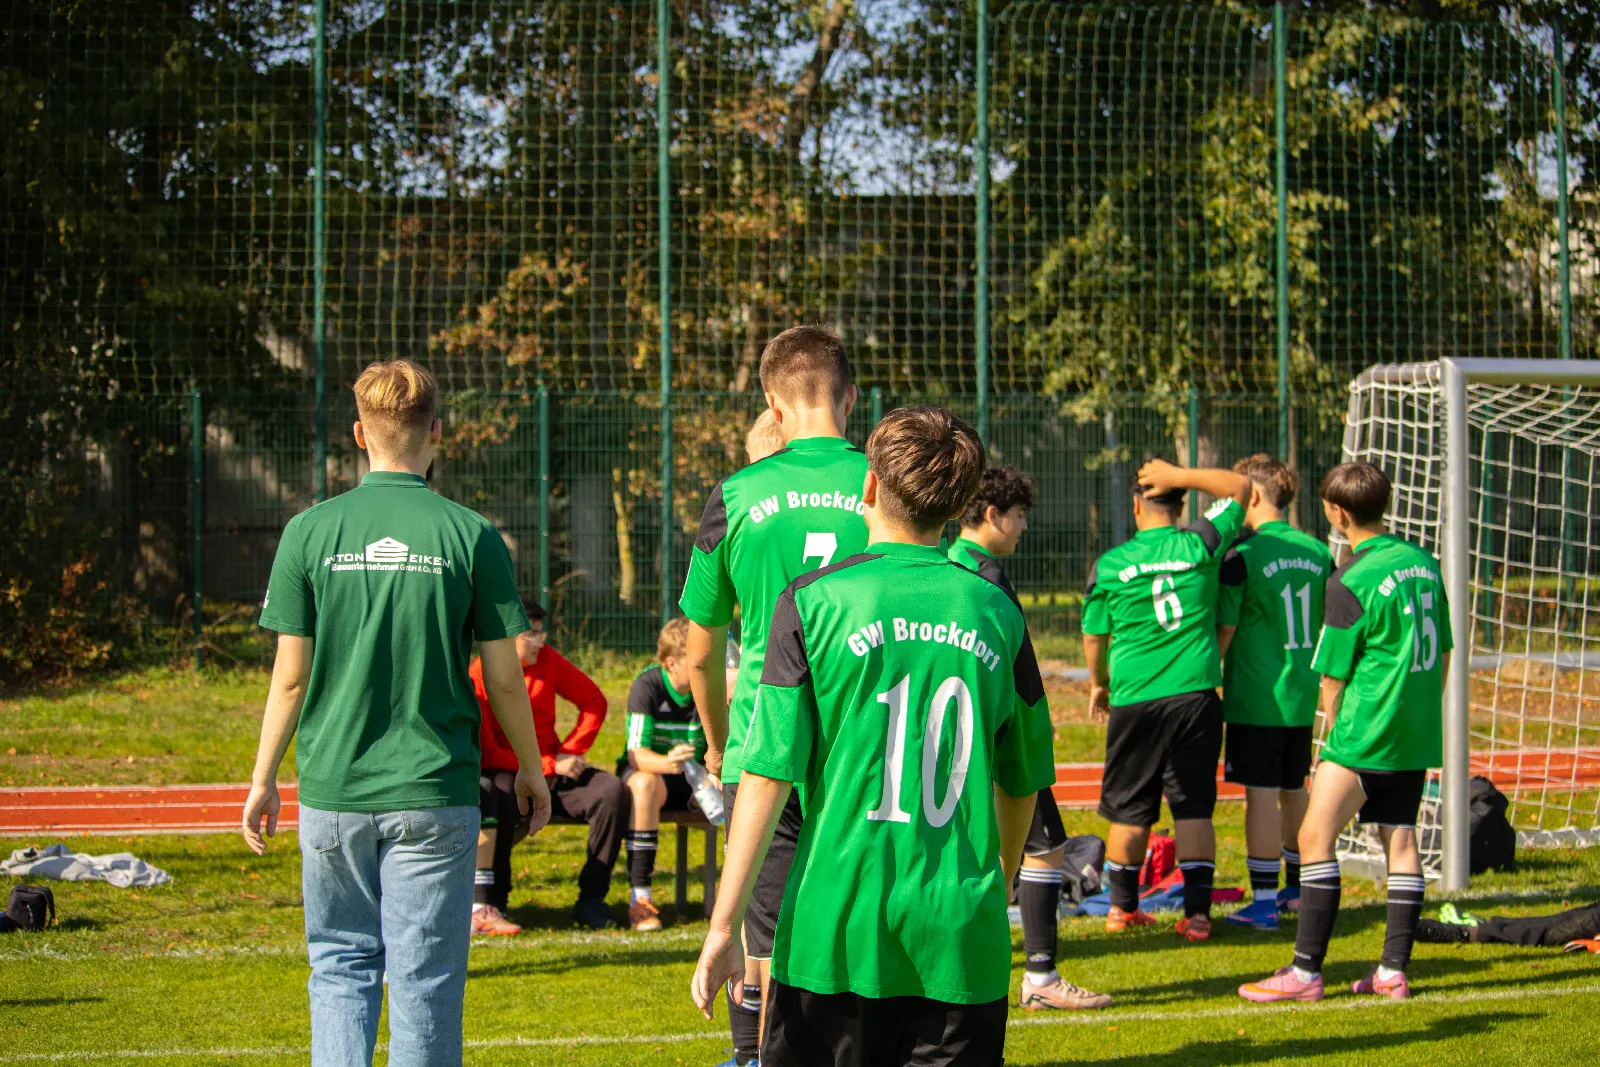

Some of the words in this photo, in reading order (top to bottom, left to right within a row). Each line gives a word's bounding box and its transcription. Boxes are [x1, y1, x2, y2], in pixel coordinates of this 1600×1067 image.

[749, 494, 780, 523] GW
[409, 554, 451, 569] EIKEN
[802, 531, 838, 569] 7
[400, 563, 417, 572] GmbH
[433, 567, 442, 575] KG
[1118, 564, 1138, 583] GW
[1262, 560, 1278, 578] GW
[1378, 574, 1396, 597] GW
[1151, 572, 1183, 632] 6
[1280, 582, 1312, 650] 11
[847, 620, 884, 657] GW
[893, 617, 1001, 672] Brockdorf
[1403, 592, 1437, 673] 15
[867, 672, 974, 828] 10
